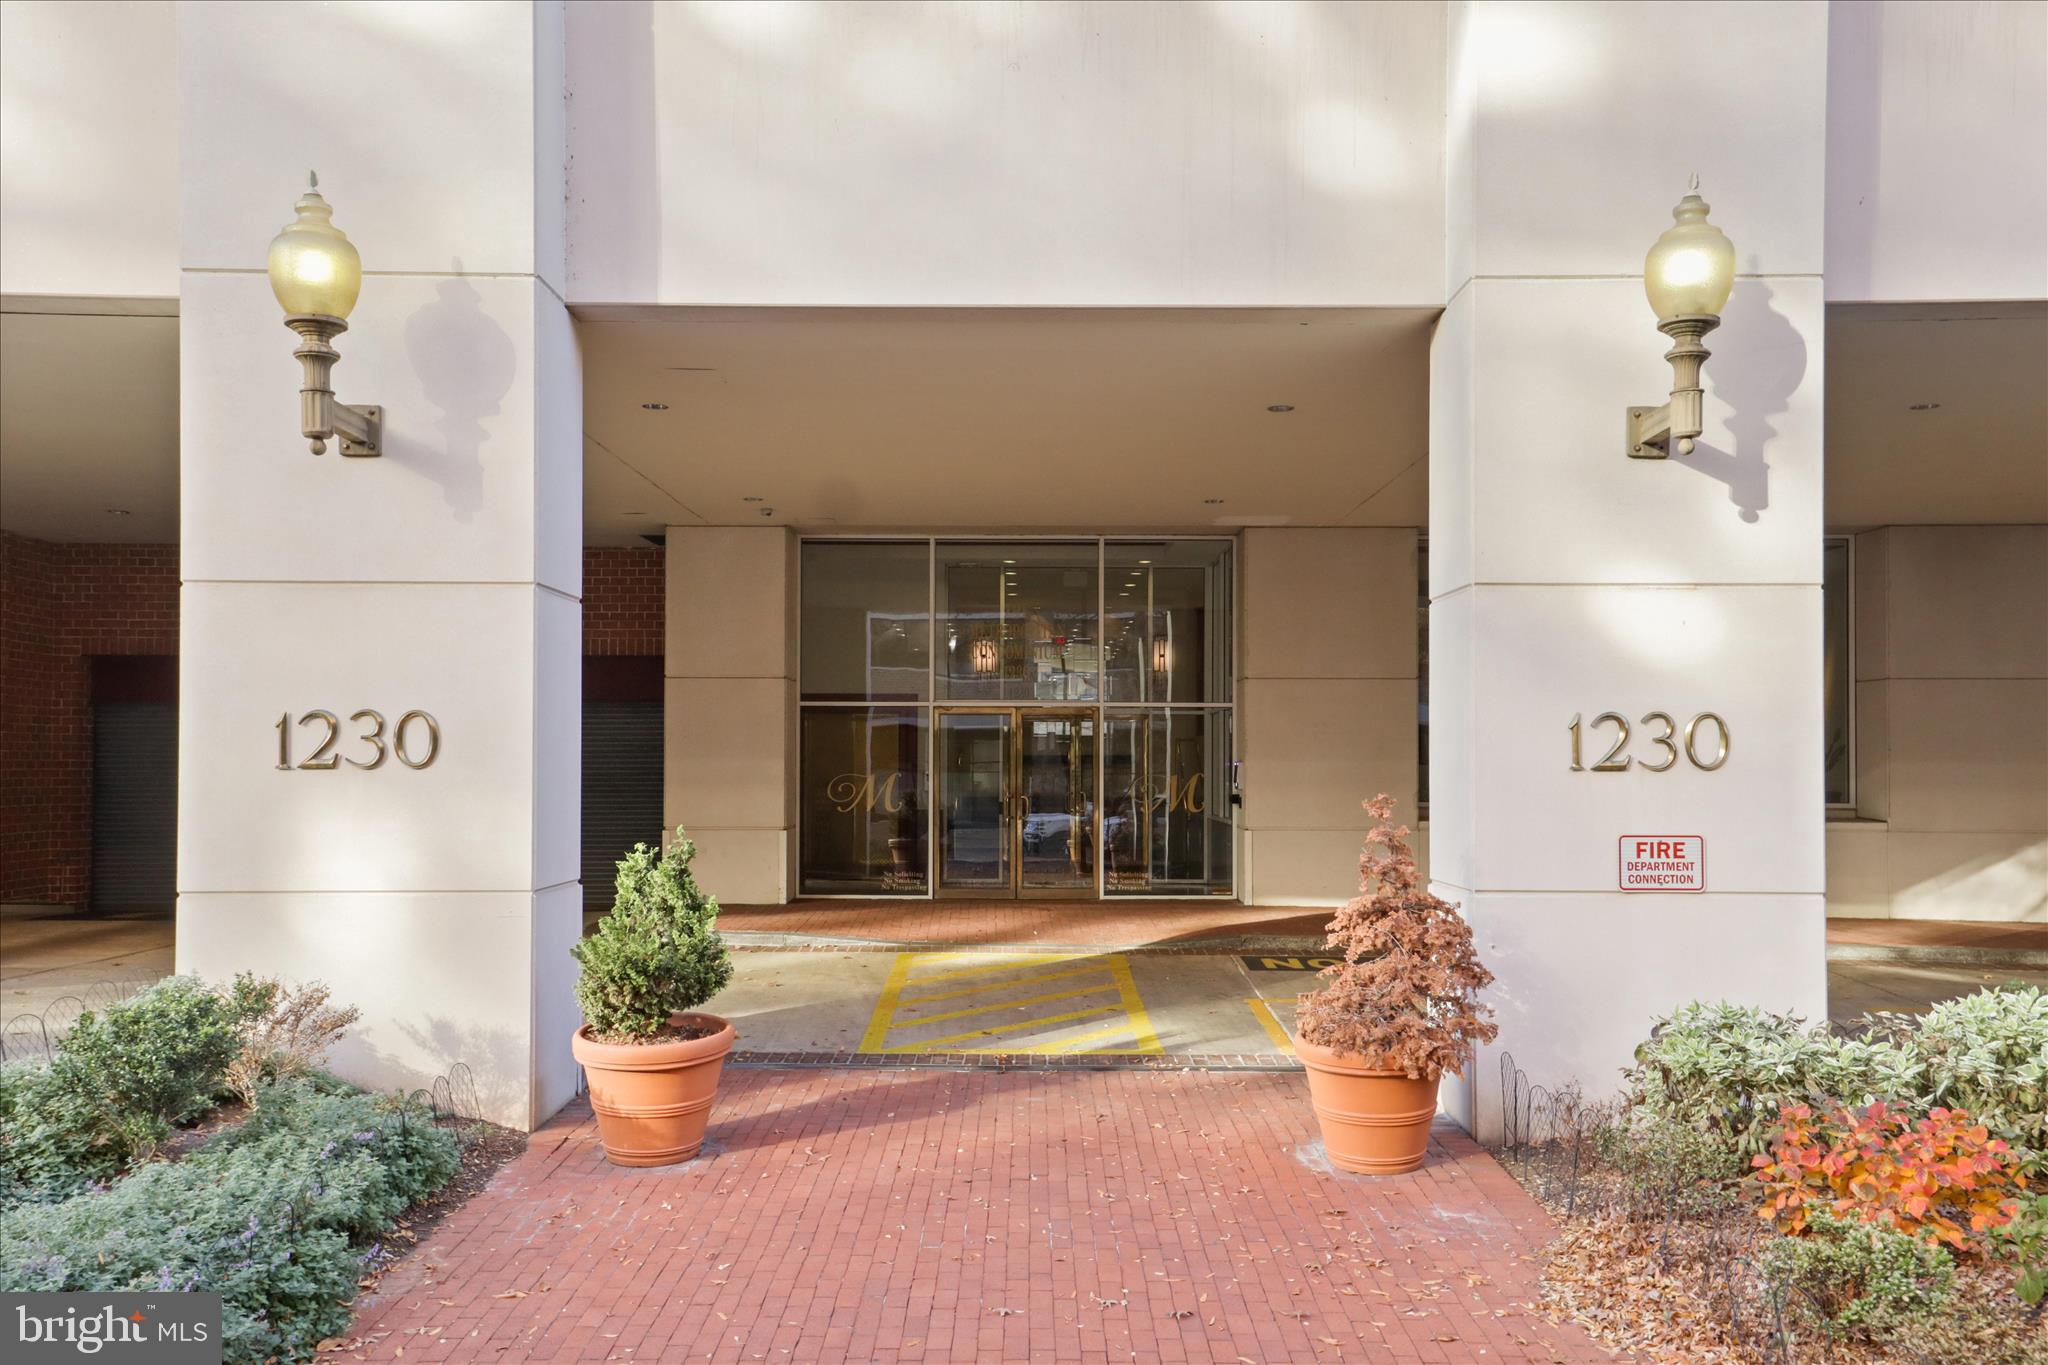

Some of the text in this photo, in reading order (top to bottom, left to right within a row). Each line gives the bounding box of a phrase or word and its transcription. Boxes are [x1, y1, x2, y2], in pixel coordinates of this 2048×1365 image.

[275, 709, 438, 770] 1230
[1567, 711, 1730, 772] 1230
[827, 772, 902, 813] M
[1636, 842, 1686, 859] FIRE
[1627, 862, 1695, 872] DEPARTMENT
[1628, 874, 1694, 884] CONNECTION
